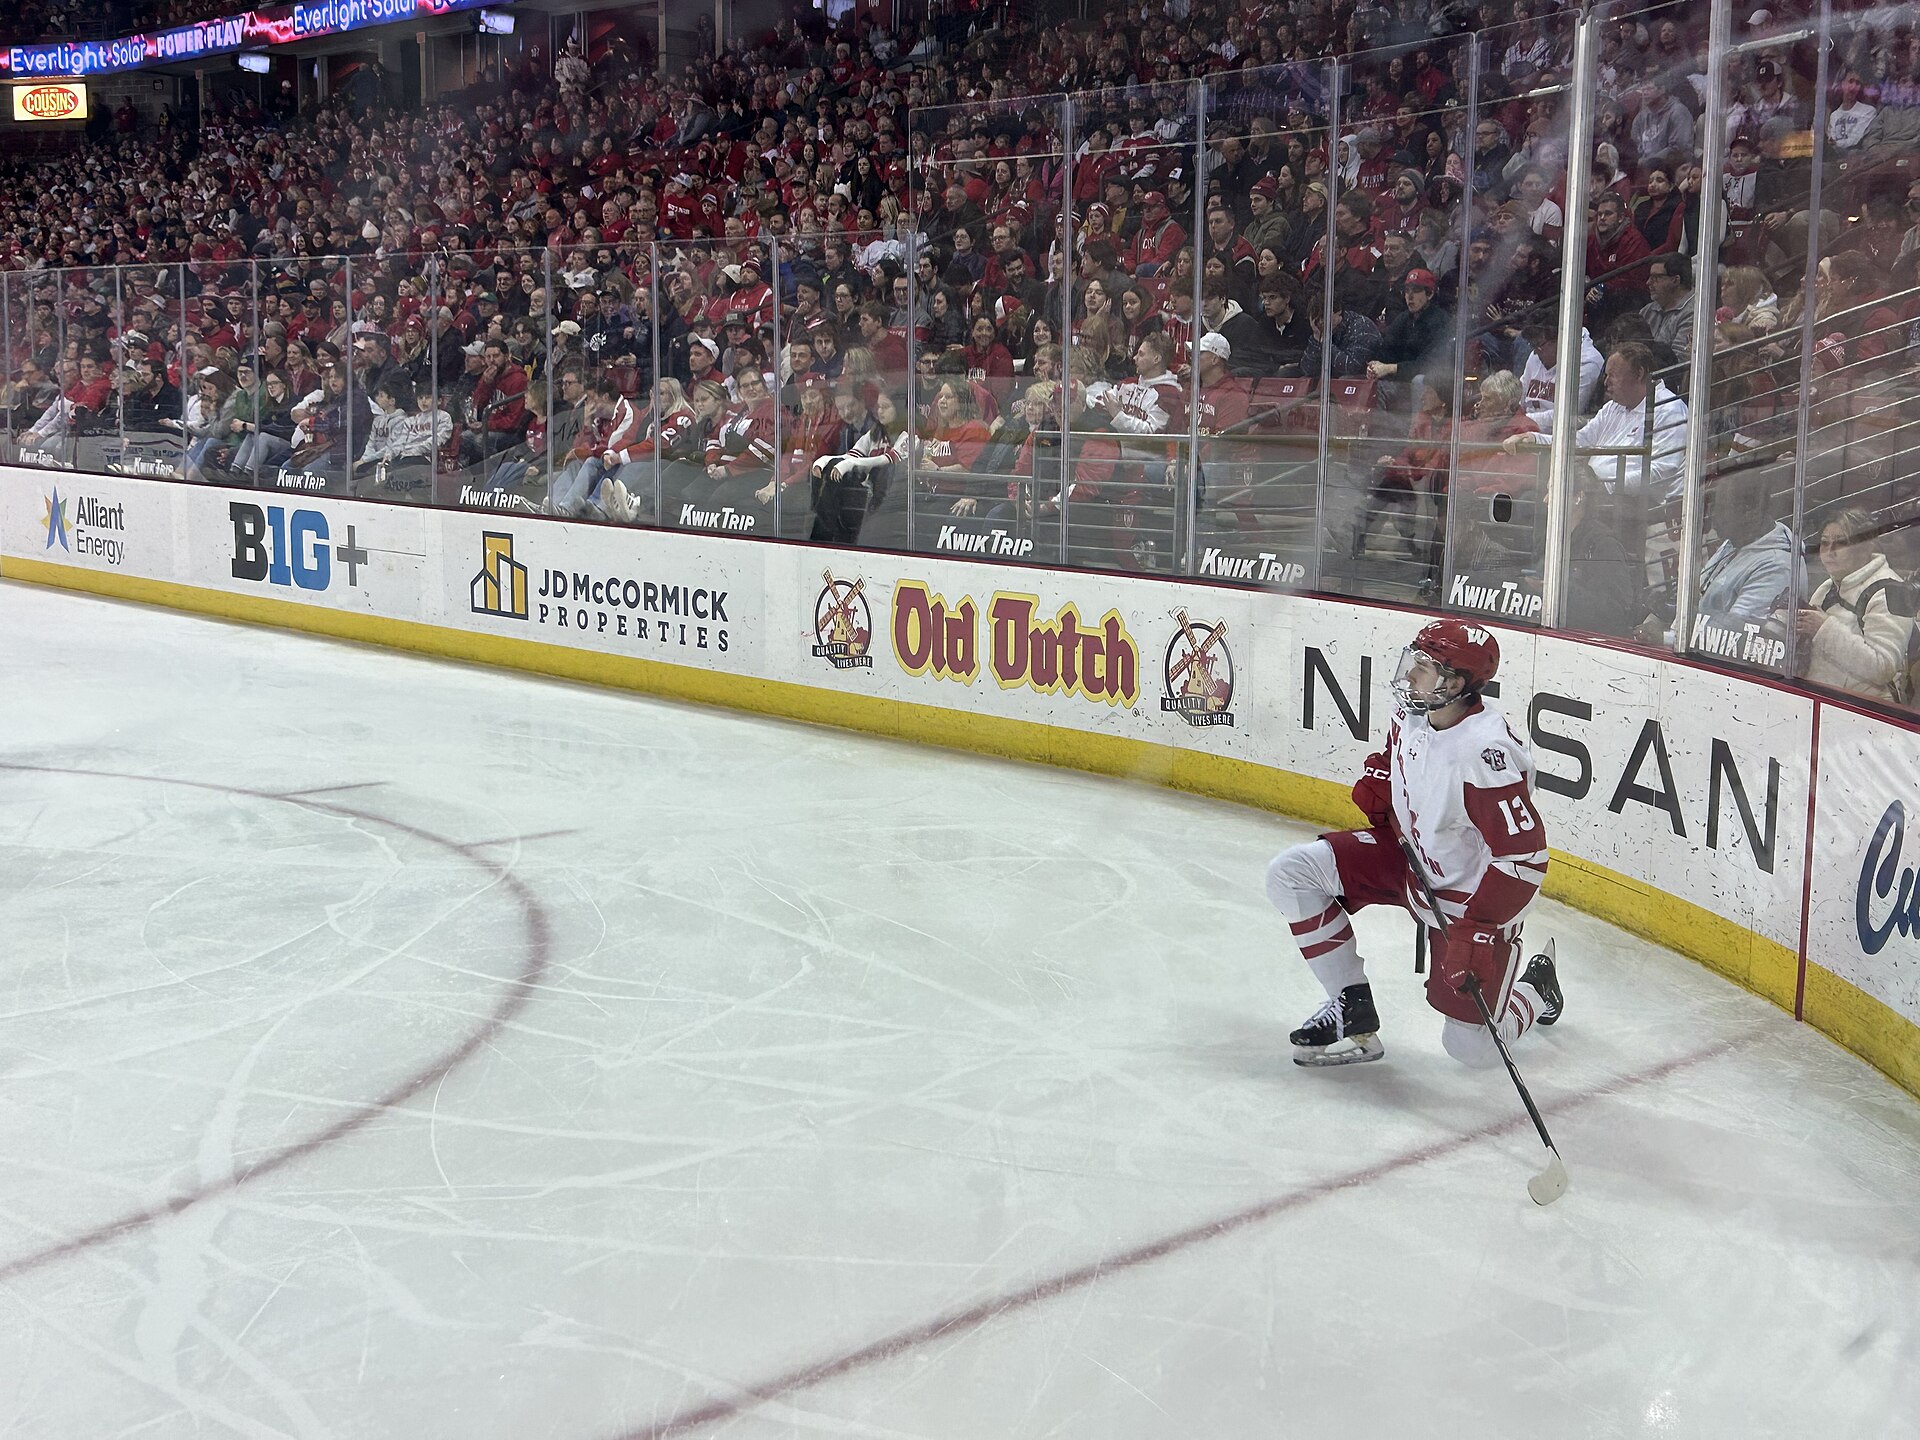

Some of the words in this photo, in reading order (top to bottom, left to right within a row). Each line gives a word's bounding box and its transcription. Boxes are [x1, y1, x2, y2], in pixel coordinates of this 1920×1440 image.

[294, 0, 367, 32] Everlight
[10, 43, 107, 74] Everlight
[112, 40, 147, 67] Solar
[157, 31, 204, 57] POWER
[207, 20, 244, 48] PLAY
[26, 92, 75, 112] COUSINS
[76, 496, 124, 530] Alliant
[77, 529, 124, 565] Energy
[538, 569, 568, 599] JD
[539, 603, 729, 652] PROPERTIES
[893, 583, 979, 681] Old
[991, 595, 1137, 703] Dutch
[816, 644, 845, 655] QUALITY
[837, 659, 853, 668] LIVES
[855, 656, 871, 668] HERE
[1165, 698, 1201, 710] QUALITY
[1192, 716, 1211, 726] LIVES
[1213, 714, 1231, 725] HERE
[1302, 646, 1781, 875] NSAN
[1365, 767, 1391, 781] CC
[1497, 795, 1536, 836] 13
